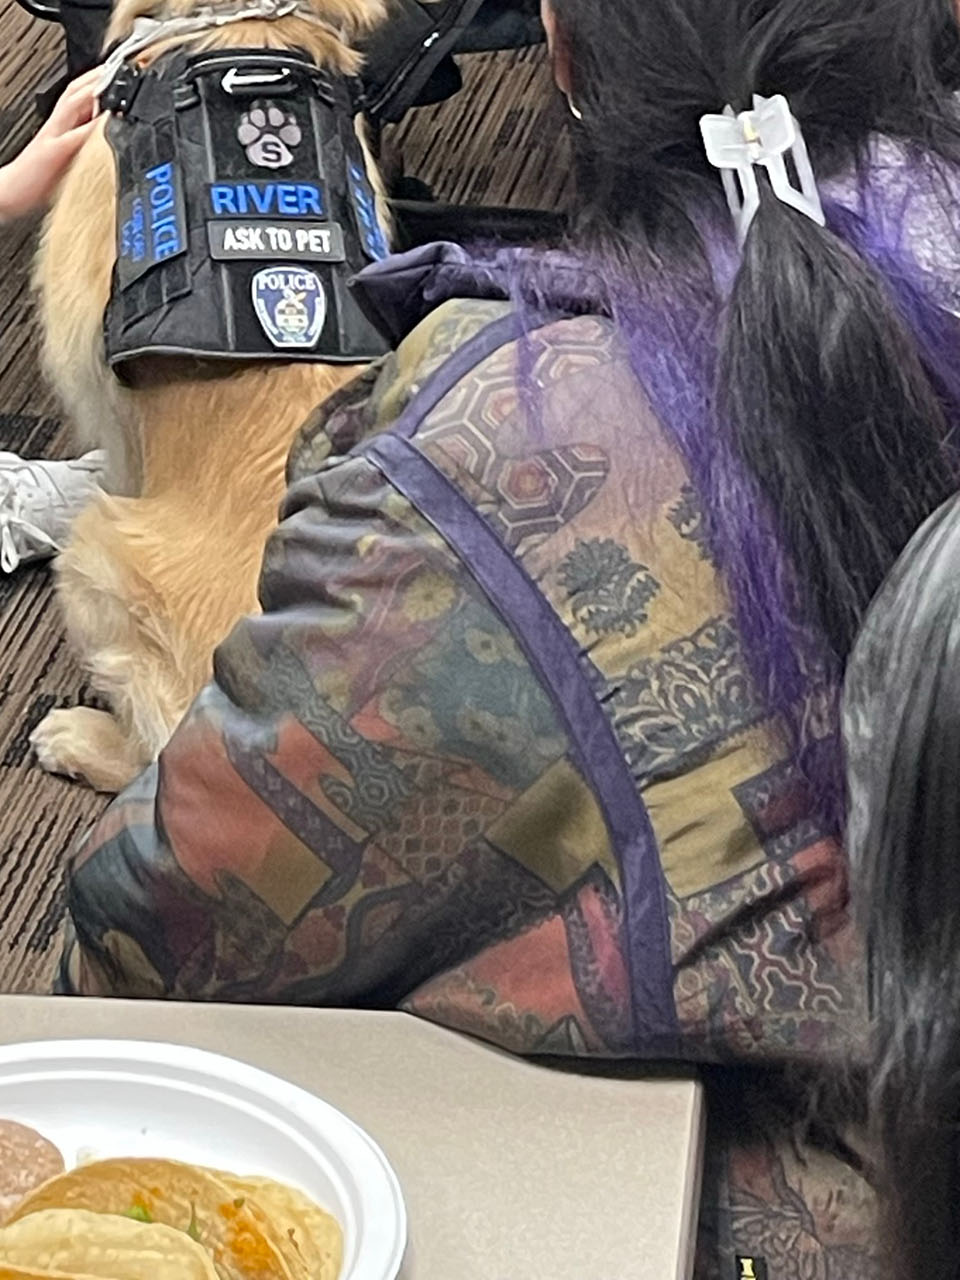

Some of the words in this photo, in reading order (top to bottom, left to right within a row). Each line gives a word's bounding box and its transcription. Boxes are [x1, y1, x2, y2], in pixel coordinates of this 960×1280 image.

[262, 142, 281, 163] S
[145, 162, 180, 261] POLICE
[210, 184, 323, 215] RIVER
[223, 227, 265, 251] ASK
[265, 227, 293, 252] TO
[295, 228, 331, 254] PET
[257, 272, 317, 291] POLICE
